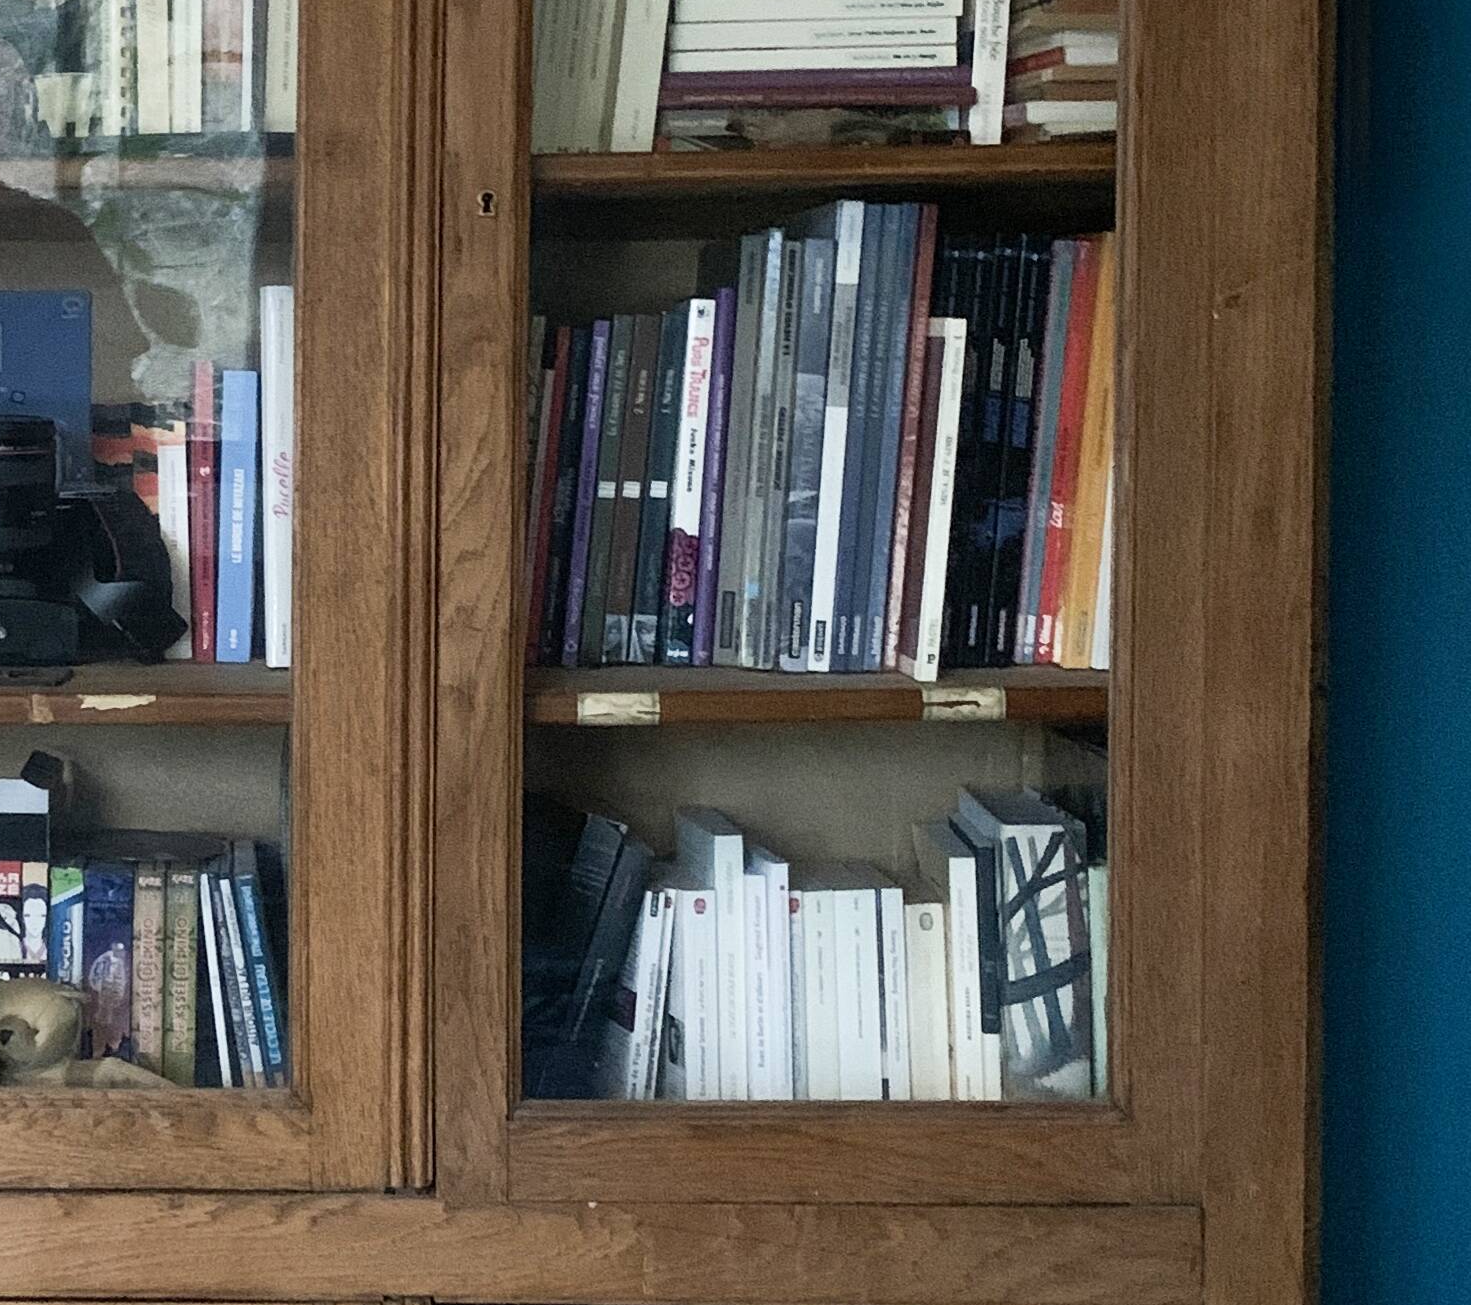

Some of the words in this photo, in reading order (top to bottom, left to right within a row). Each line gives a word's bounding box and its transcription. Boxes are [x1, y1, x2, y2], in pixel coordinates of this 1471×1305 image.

[232, 469, 246, 510] MIYAZAKI
[232, 510, 244, 521] DE
[231, 522, 244, 552] MONDE
[231, 553, 243, 564] LE
[263, 1014, 279, 1049] CYCLE
